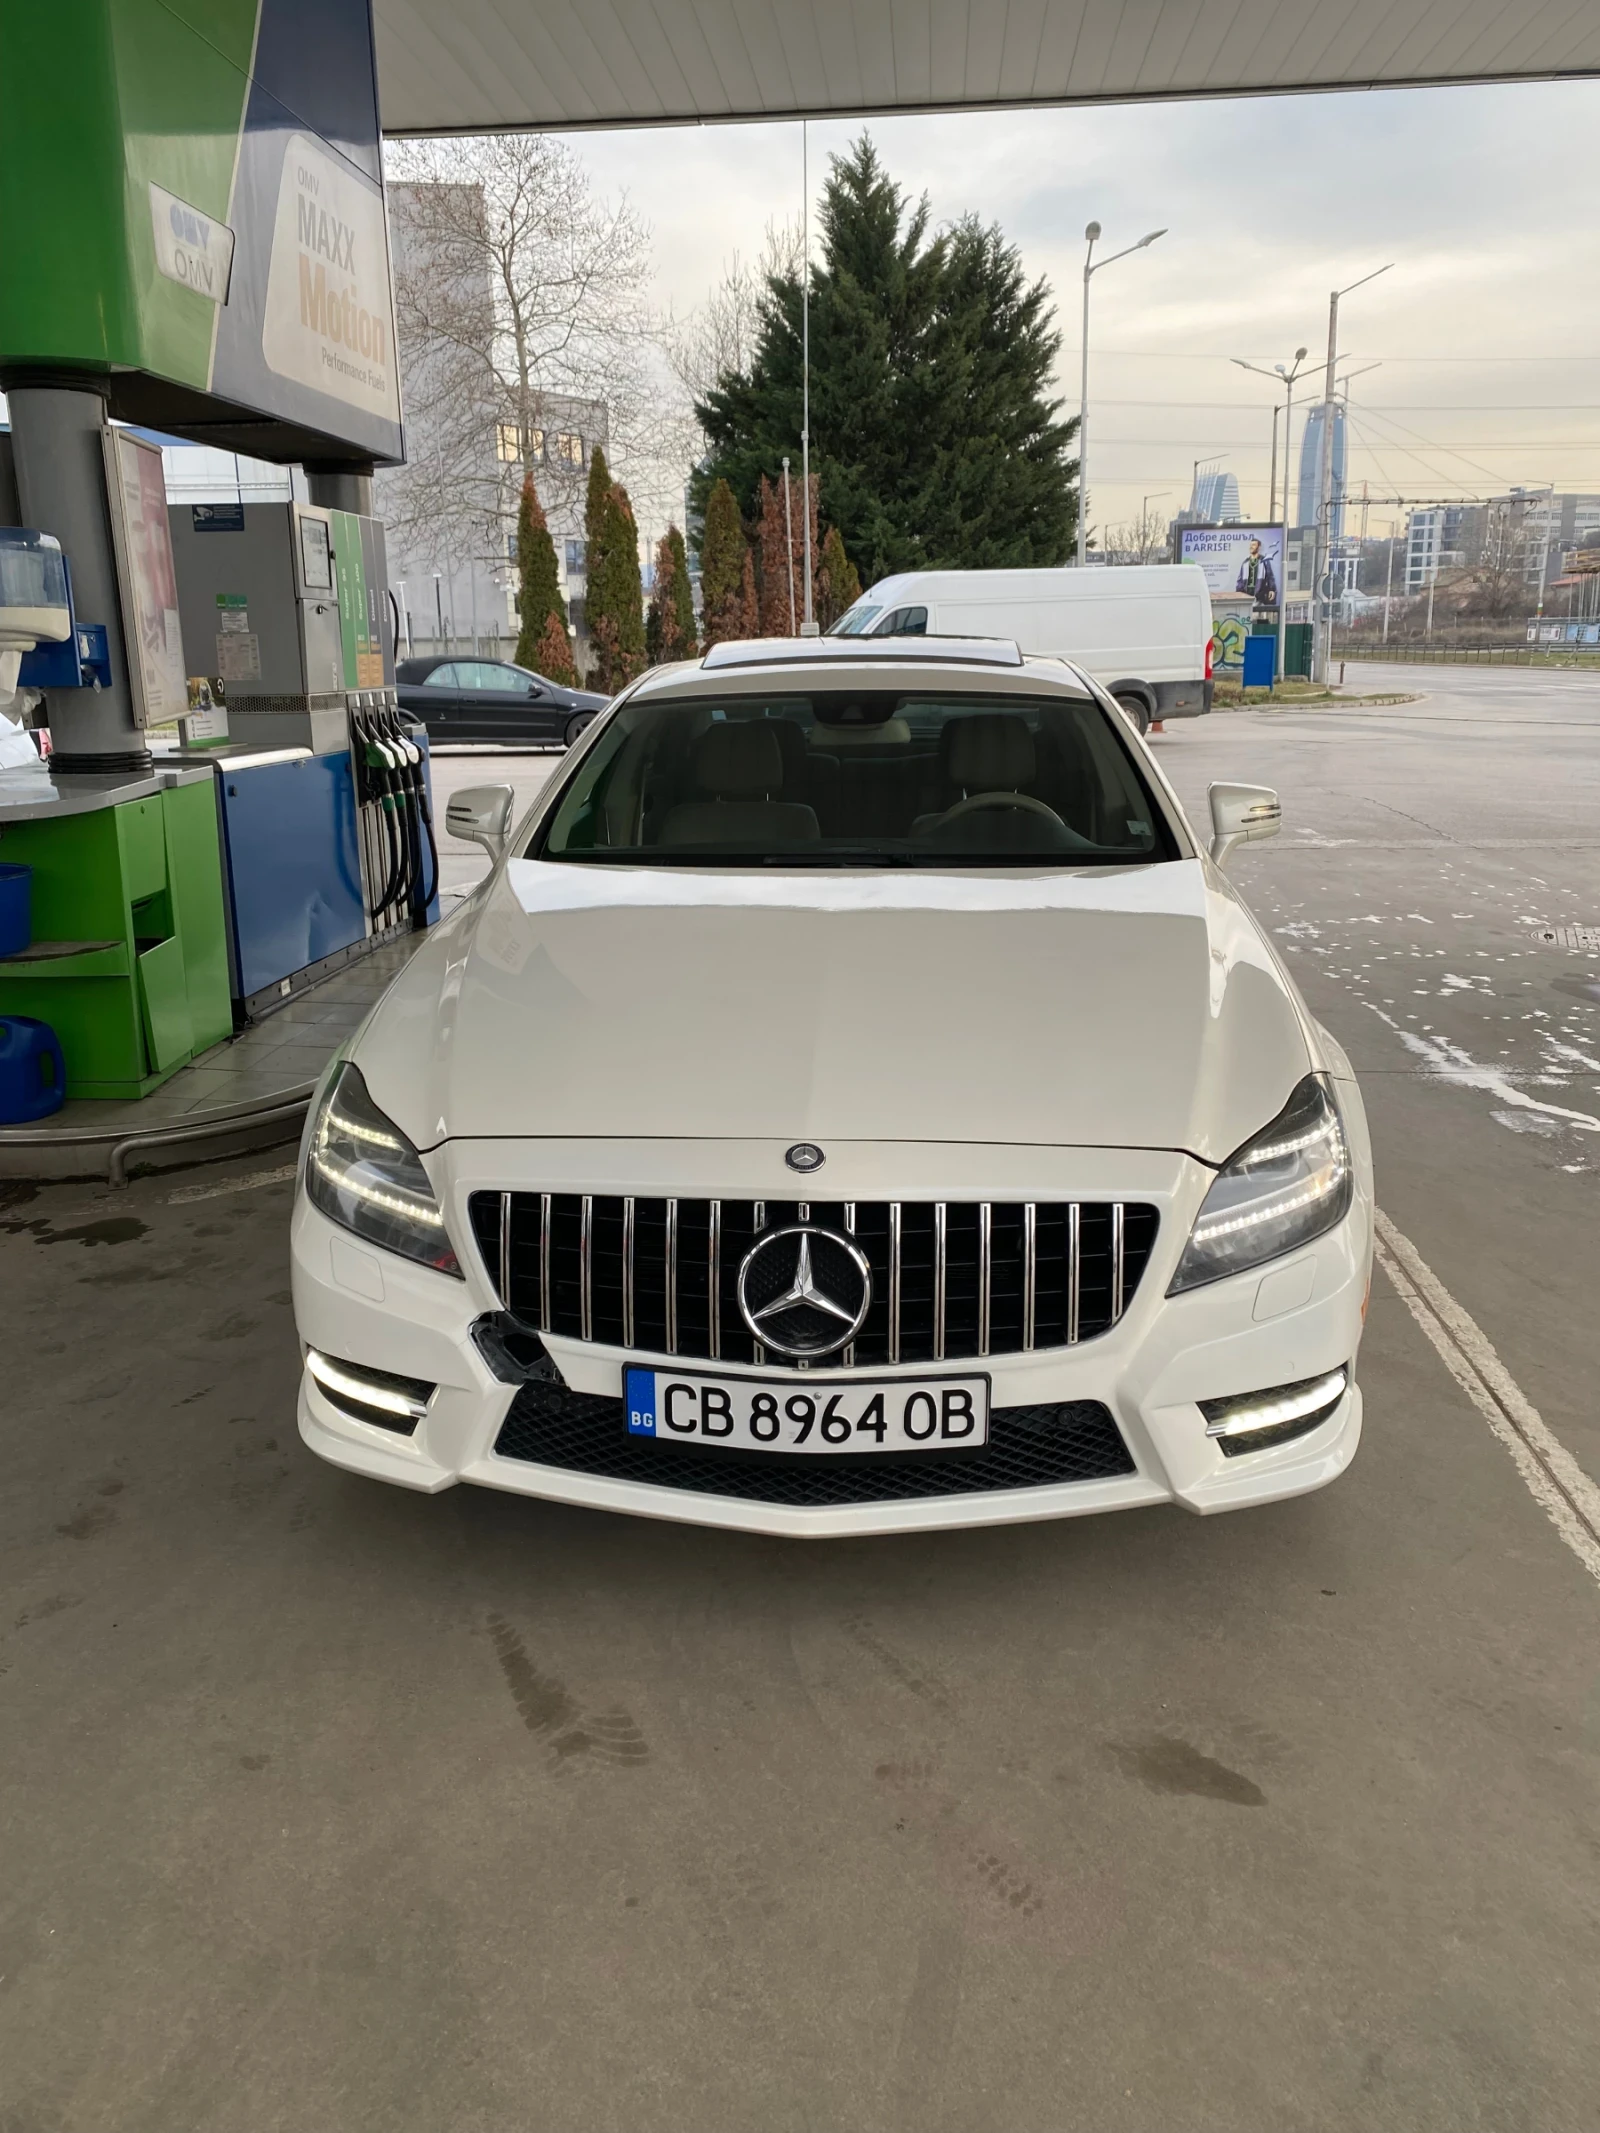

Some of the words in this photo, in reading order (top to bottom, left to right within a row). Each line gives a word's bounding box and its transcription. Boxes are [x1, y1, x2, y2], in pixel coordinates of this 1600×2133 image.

[297, 165, 320, 197] OMV
[170, 204, 210, 250] OMV
[298, 192, 356, 276] MAXX
[175, 248, 213, 292] OMV
[298, 252, 386, 366] Motion
[322, 345, 367, 384] Performance
[367, 370, 386, 393] Fuels
[1185, 532, 1217, 542] Добре
[1219, 533, 1255, 541] дошъл
[1193, 543, 1231, 552] ARRISE!
[631, 1411, 653, 1428] BG
[664, 1383, 735, 1436] CB
[749, 1391, 888, 1444] 8964
